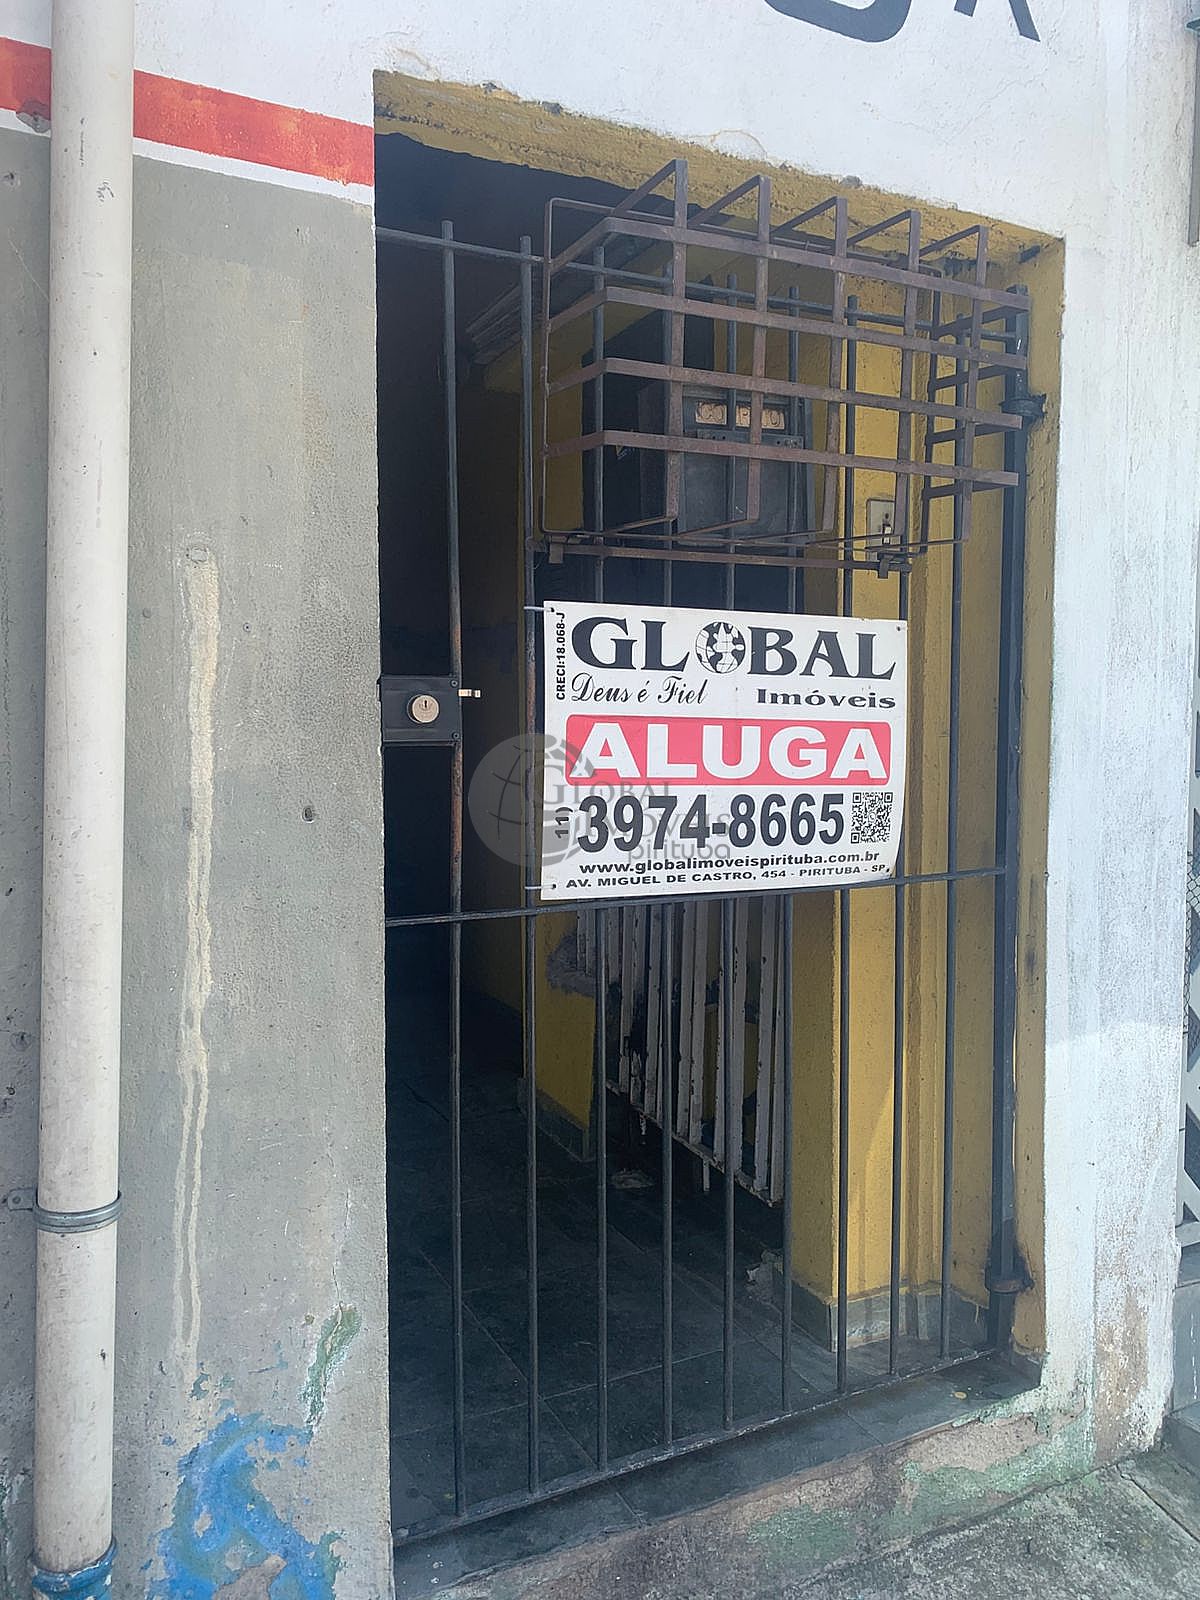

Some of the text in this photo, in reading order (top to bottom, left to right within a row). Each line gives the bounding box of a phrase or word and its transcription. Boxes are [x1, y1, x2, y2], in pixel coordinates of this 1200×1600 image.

[555, 612, 566, 700] CRECI:18.068-J
[571, 616, 896, 681] GLOBAL
[571, 672, 709, 705] Deus é Fiel
[757, 688, 896, 709] Imóveis
[568, 722, 889, 780] ALUGA
[577, 793, 844, 853] 3974-8665
[566, 879, 592, 889] AV.
[597, 874, 661, 887] MIGUEL
[666, 874, 687, 884] DE
[692, 868, 757, 881] CASTRO,
[761, 870, 787, 879] 454
[799, 866, 861, 877] PIRITUBA
[579, 851, 880, 875] www.globalimoveispirituba.com.br
